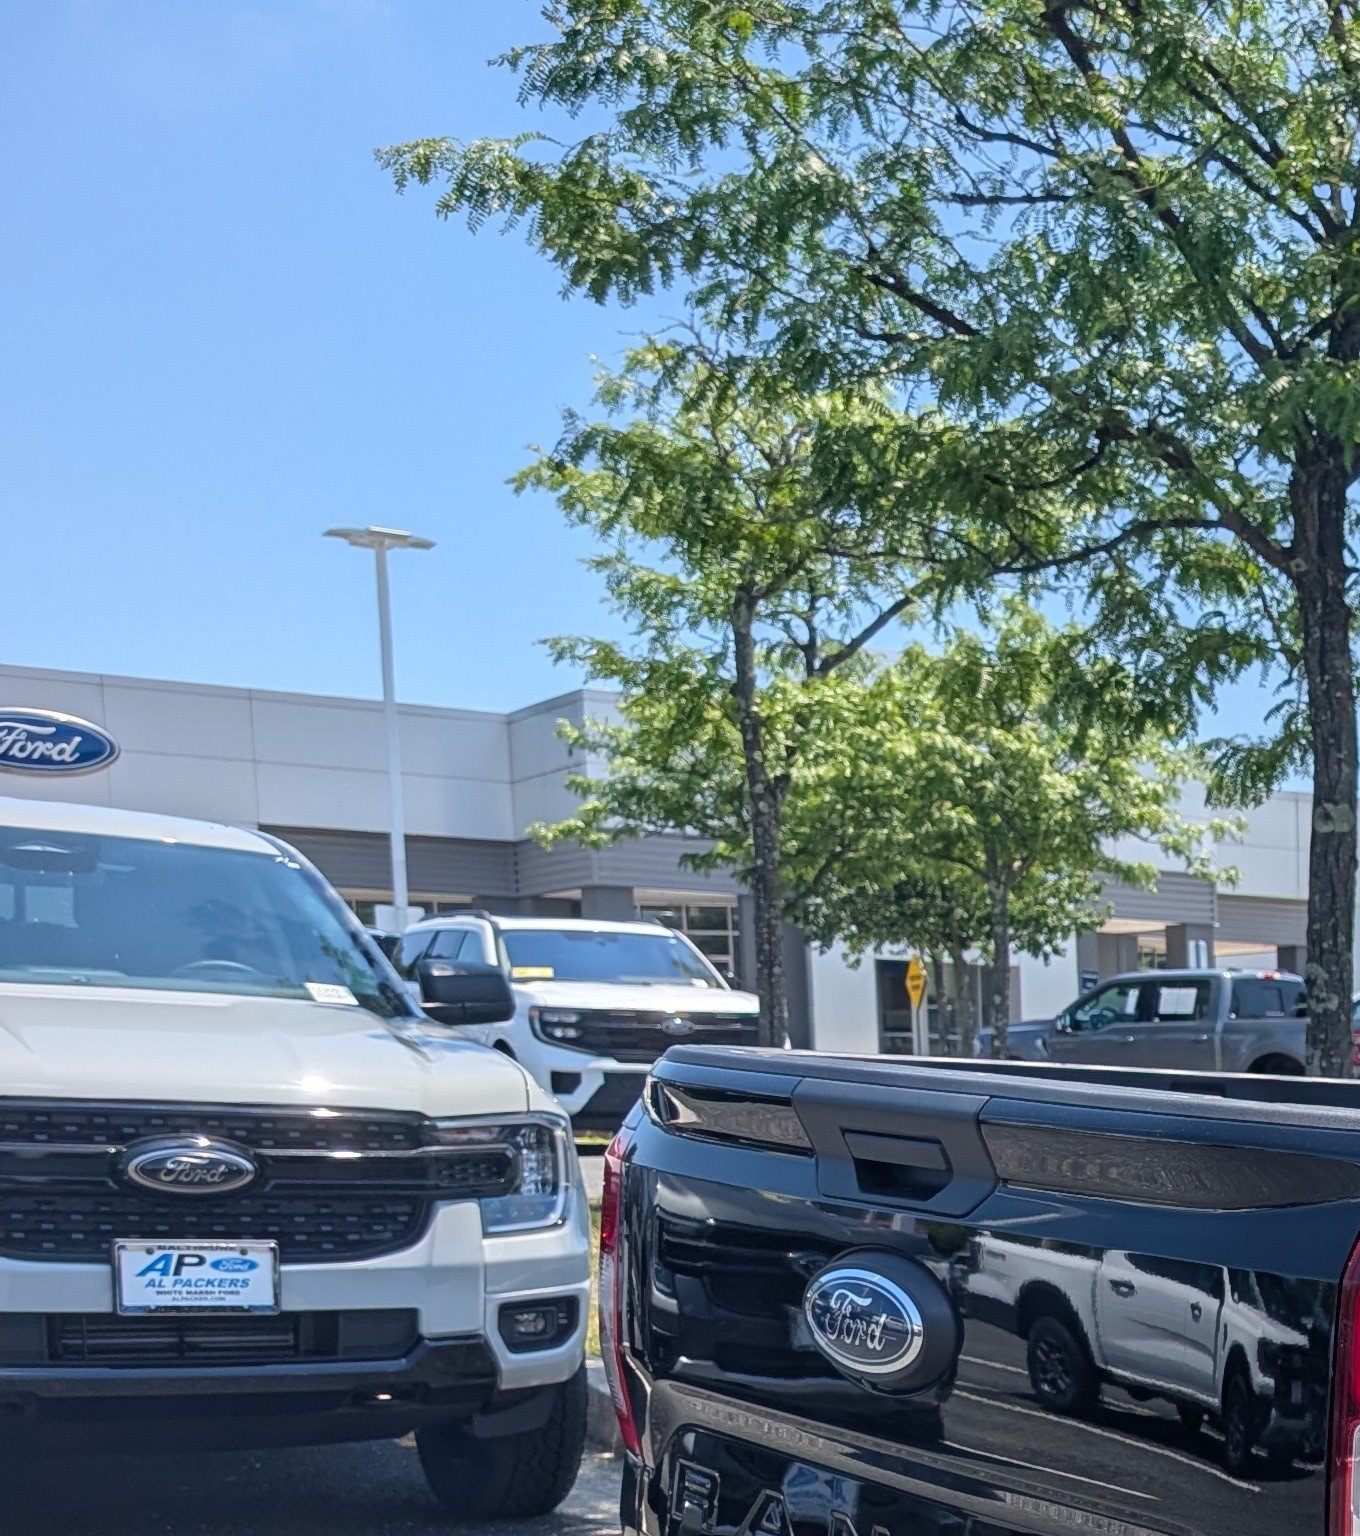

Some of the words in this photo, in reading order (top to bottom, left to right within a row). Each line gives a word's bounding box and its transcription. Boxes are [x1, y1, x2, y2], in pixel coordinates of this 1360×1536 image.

[0, 721, 83, 763] Ford
[159, 1156, 228, 1183] Ford
[135, 1253, 208, 1278] AP
[218, 1258, 250, 1272] Ford
[144, 1278, 168, 1290] AL
[171, 1277, 251, 1290] PACKERS
[824, 1288, 888, 1351] Ford
